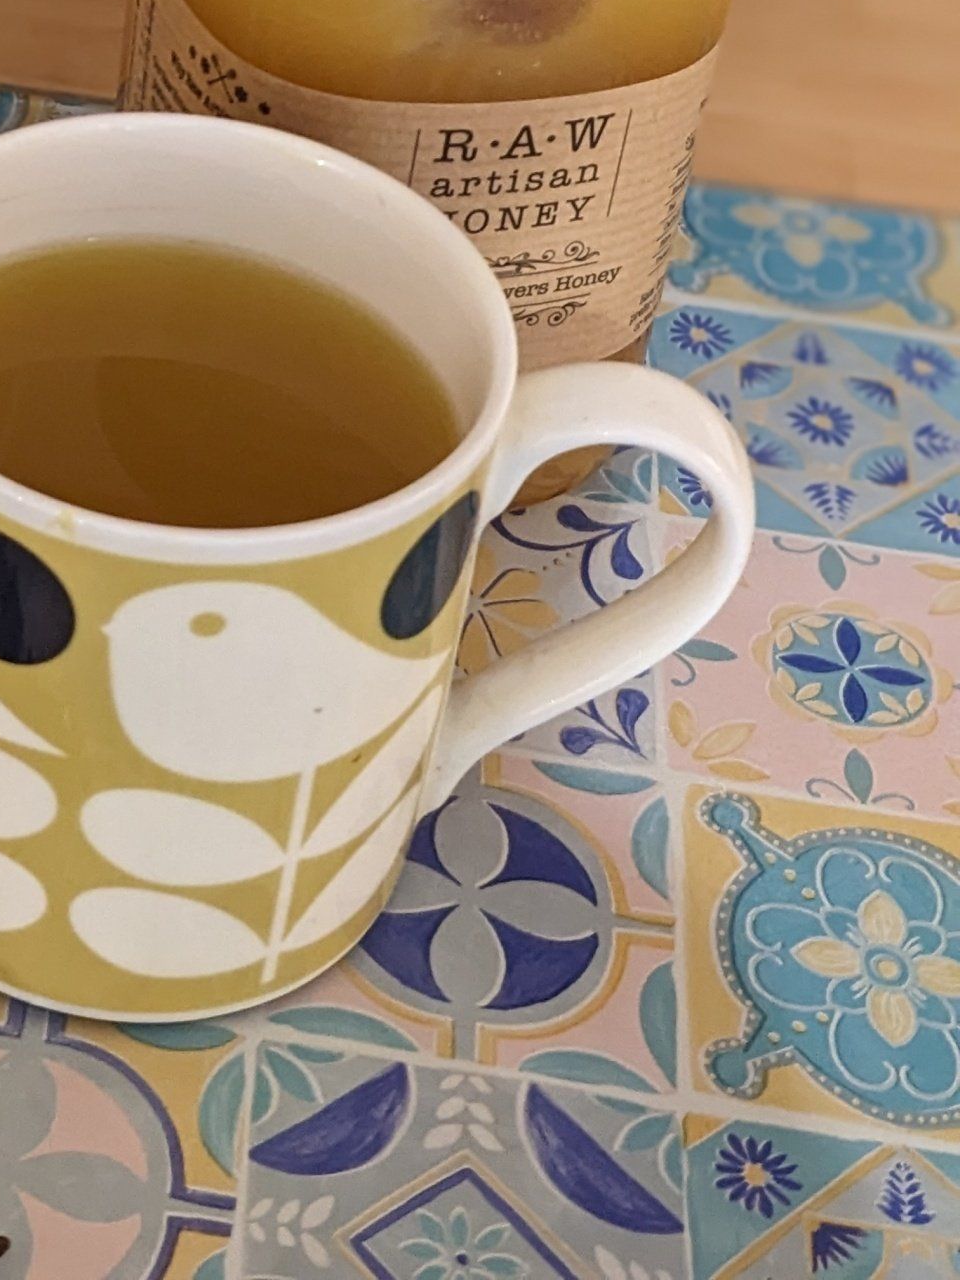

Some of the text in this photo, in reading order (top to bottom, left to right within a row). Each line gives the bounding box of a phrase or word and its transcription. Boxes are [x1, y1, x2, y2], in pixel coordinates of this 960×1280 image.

[429, 162, 601, 198] artisan
[442, 194, 597, 235] ONEY
[553, 265, 623, 293] Honey
